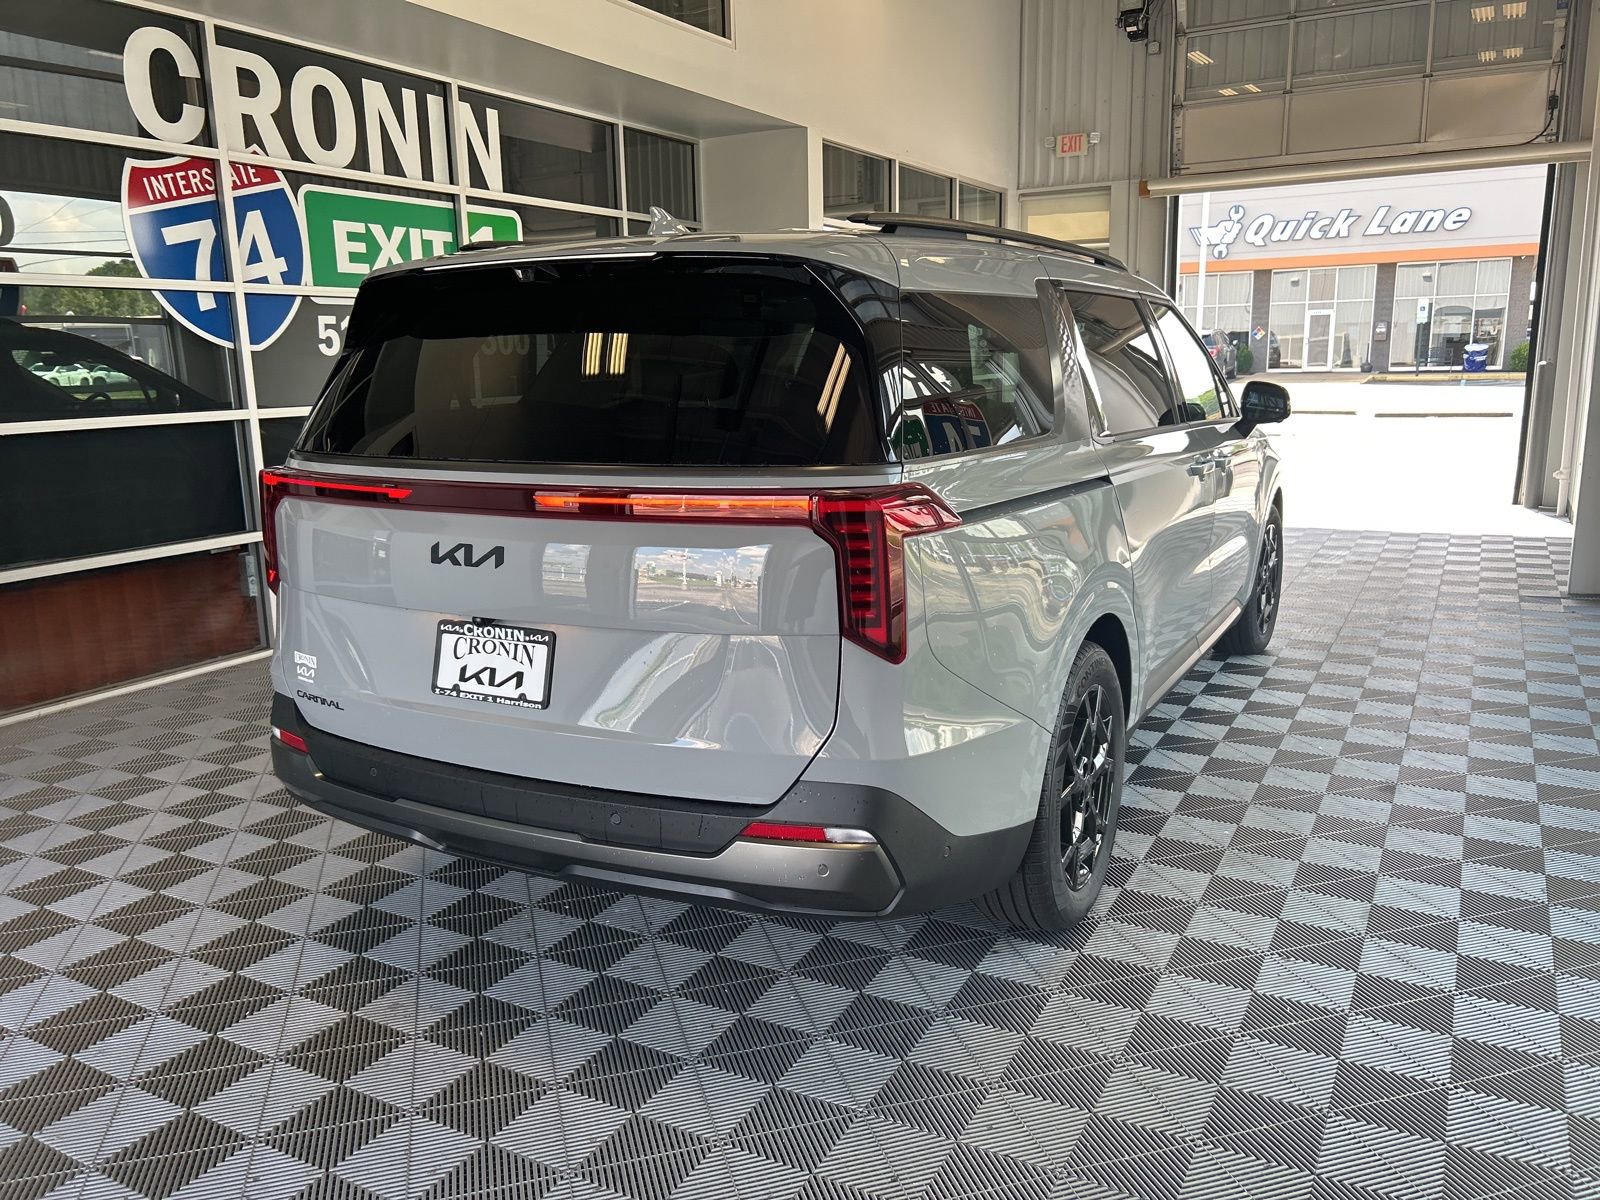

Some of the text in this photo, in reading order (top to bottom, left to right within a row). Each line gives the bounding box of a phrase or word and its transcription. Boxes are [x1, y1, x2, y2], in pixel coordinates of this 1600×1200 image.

[123, 26, 502, 192] CRONIN
[1061, 134, 1083, 153] EXIT
[143, 163, 262, 201] INTERSATE
[1244, 206, 1472, 246] Quick Lane
[161, 210, 288, 312] 74
[332, 220, 453, 274] EXIT
[431, 541, 504, 569] KIA
[463, 624, 525, 641] CRONIN
[453, 636, 536, 670] CRONIN
[458, 663, 524, 690] KIA
[296, 690, 345, 711] CARNIVAL
[435, 689, 458, 697] I-74
[460, 692, 485, 701] EXIT
[496, 697, 542, 709] Harrison
